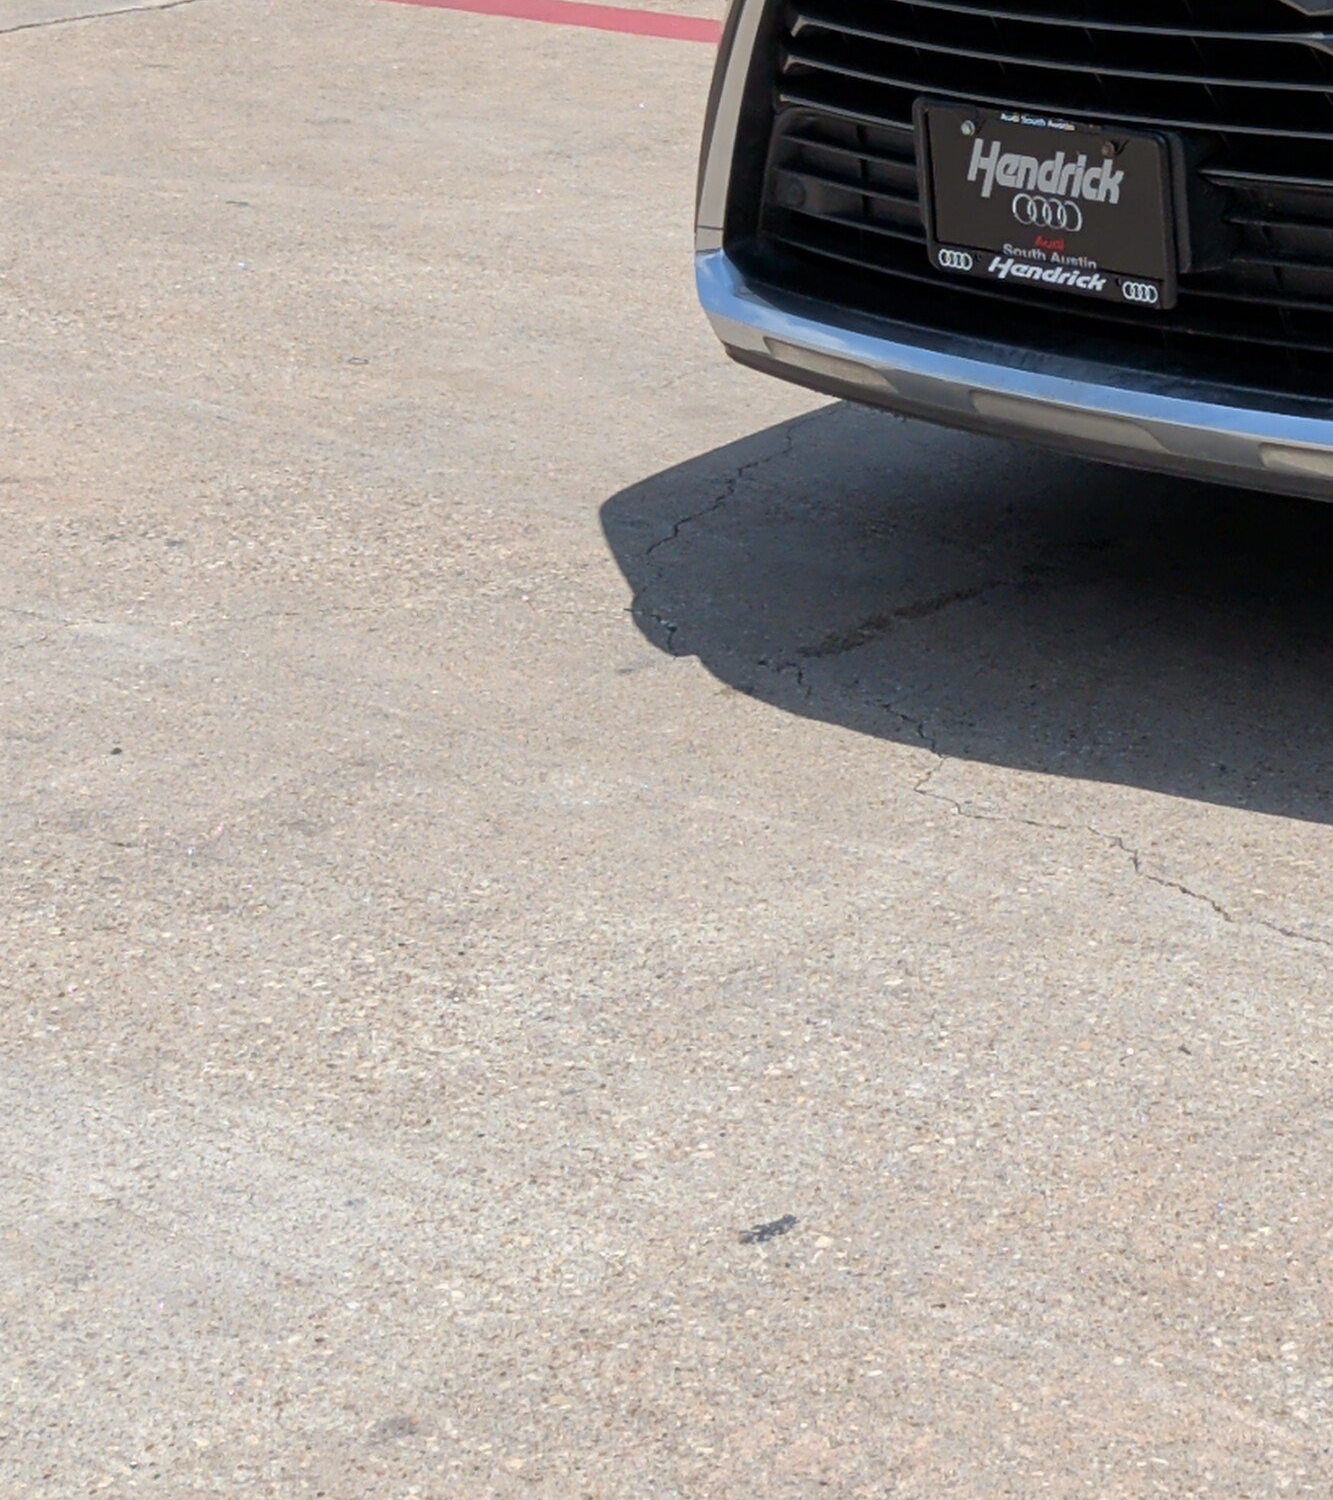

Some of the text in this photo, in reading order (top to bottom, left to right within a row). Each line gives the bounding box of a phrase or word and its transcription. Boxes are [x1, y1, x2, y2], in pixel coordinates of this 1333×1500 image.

[967, 138, 1124, 204] Hendrick
[1003, 243, 1097, 269] South Austin
[1035, 235, 1065, 251] Audi
[988, 257, 1107, 291] Hendrick
